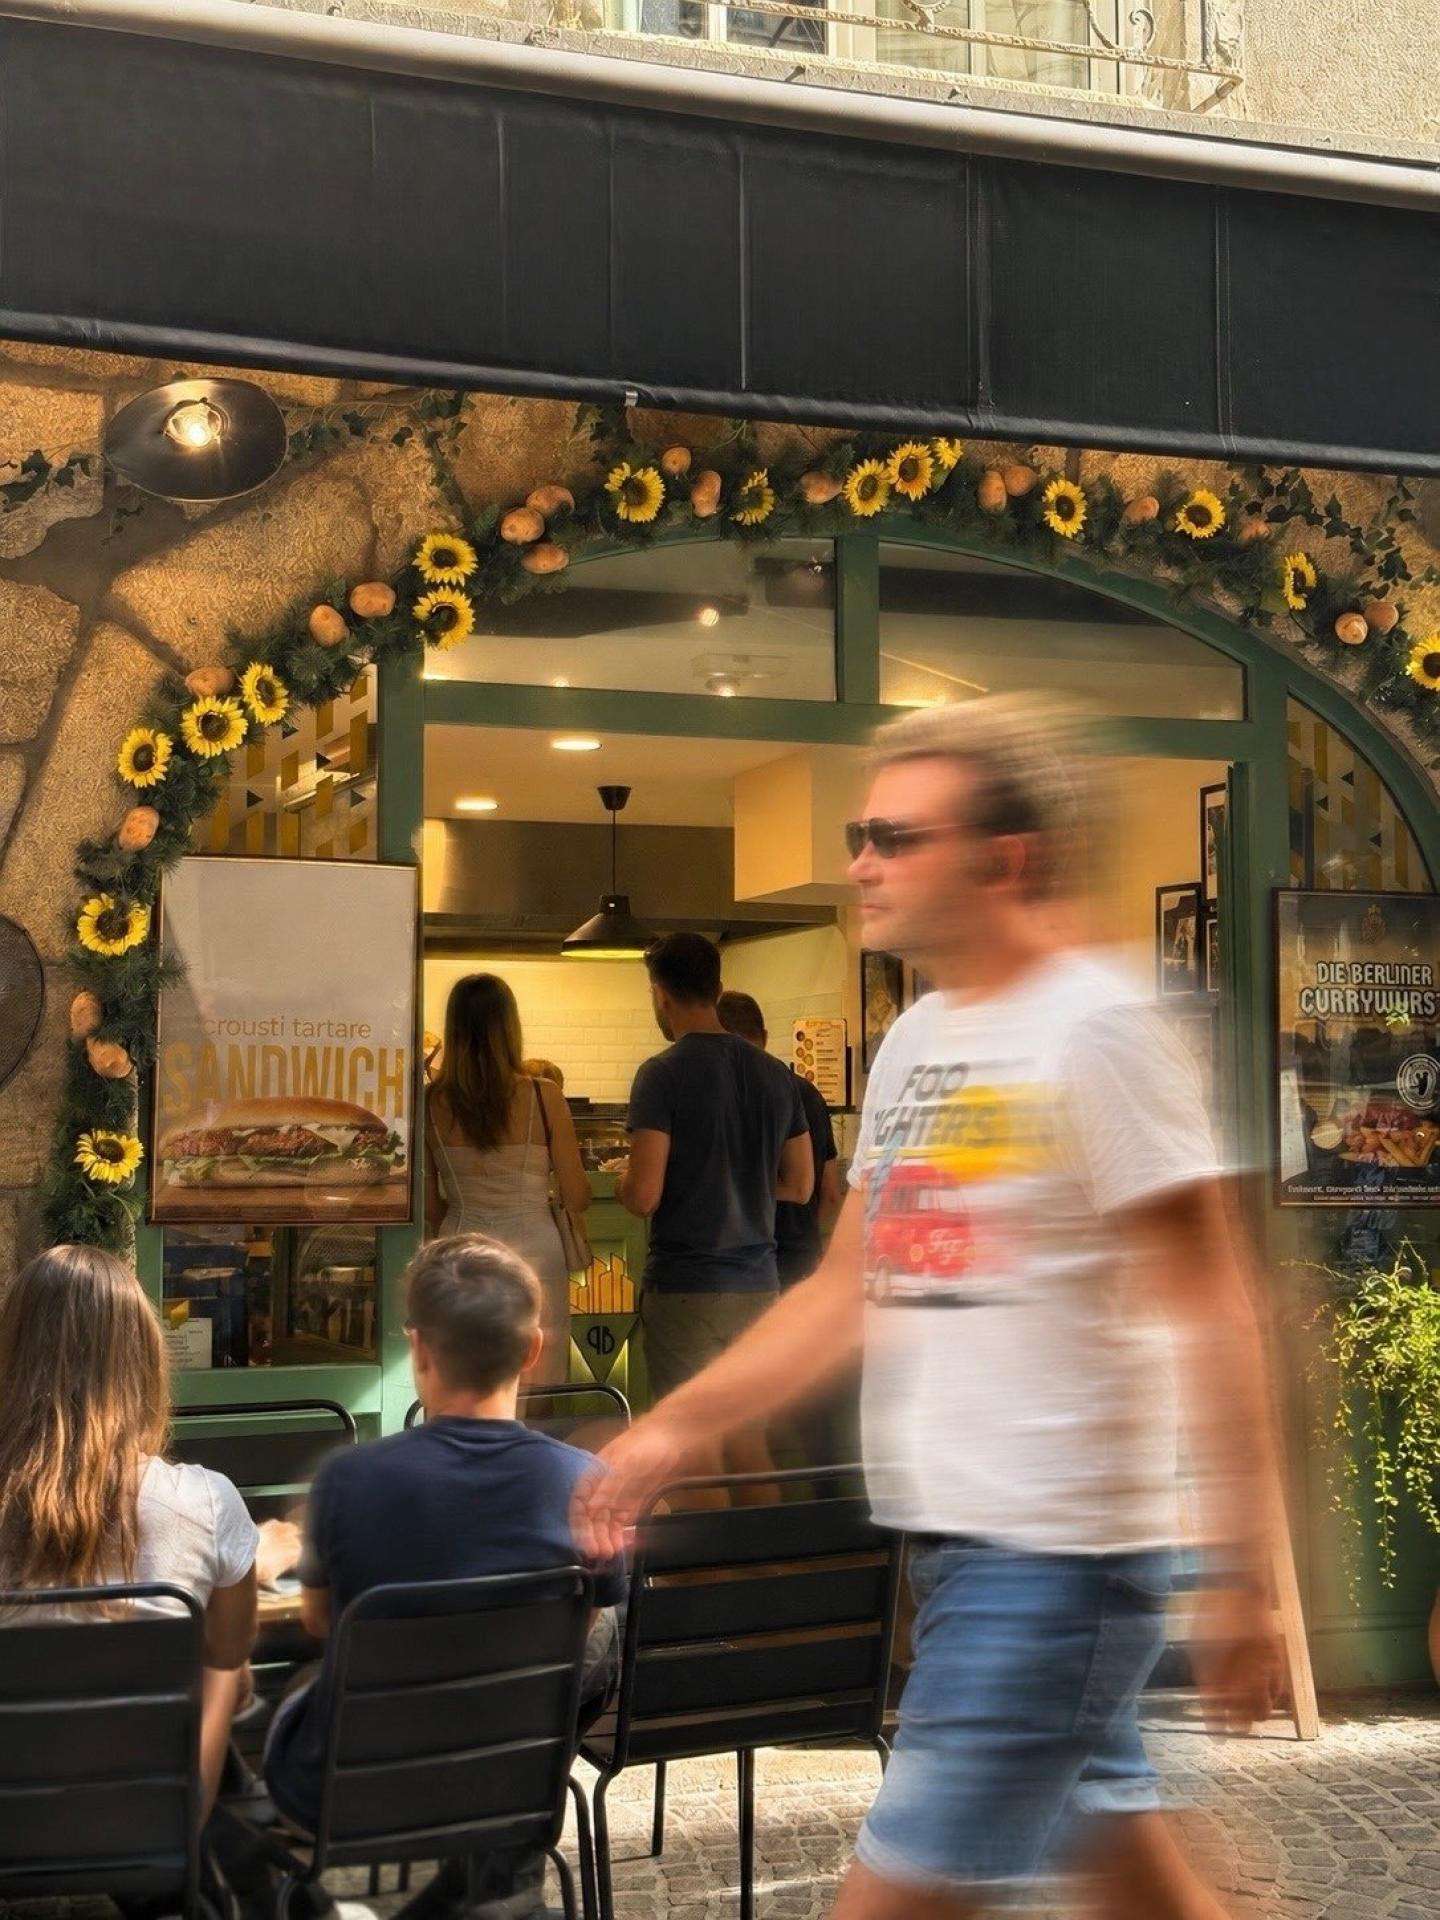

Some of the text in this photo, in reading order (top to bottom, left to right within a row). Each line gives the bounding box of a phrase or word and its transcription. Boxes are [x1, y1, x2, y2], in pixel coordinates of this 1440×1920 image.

[1317, 962, 1432, 985] DIE BERLINER
[1300, 988, 1440, 1015] CURRYWURS
[204, 1016, 372, 1040] crousti tartare
[163, 1040, 405, 1119] SANDWICH
